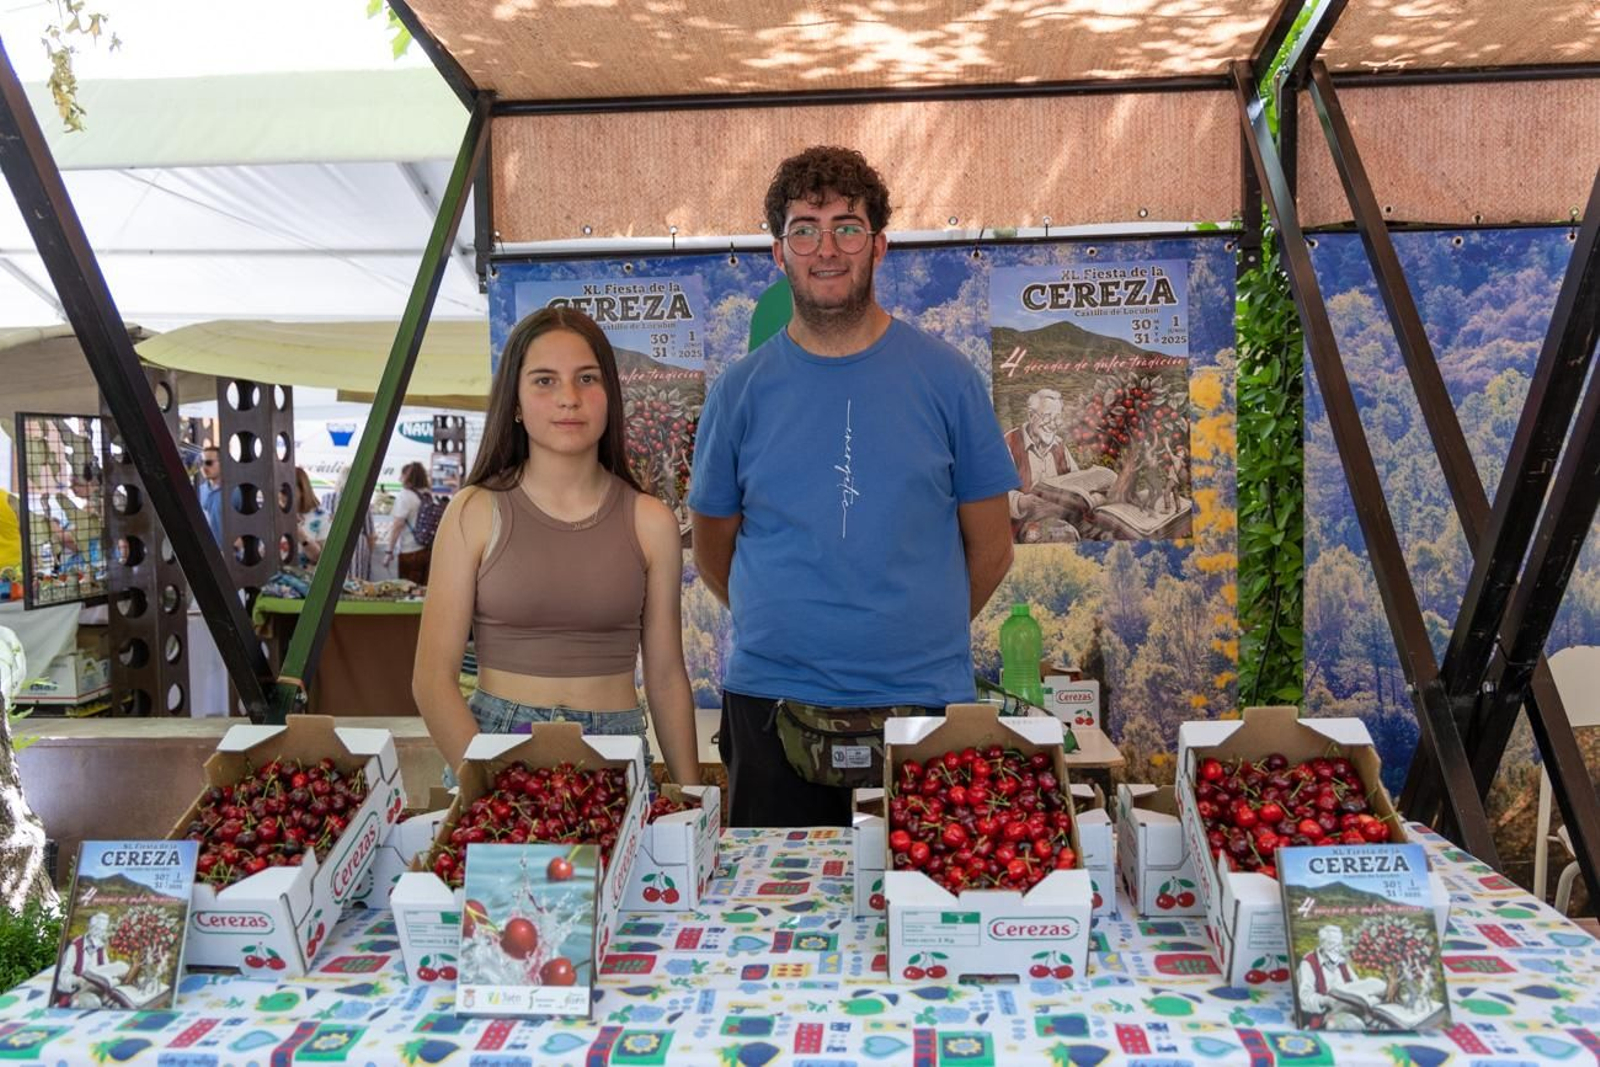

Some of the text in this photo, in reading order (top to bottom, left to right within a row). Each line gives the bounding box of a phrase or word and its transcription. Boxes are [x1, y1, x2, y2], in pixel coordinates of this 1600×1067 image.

[1061, 266, 1164, 281] XL Fiesta de la
[583, 281, 681, 295] XL Fiesta de la
[1022, 278, 1177, 311] CEREZA
[1131, 319, 1152, 331] 30
[1172, 315, 1180, 327] 1
[650, 333, 669, 345] 30
[688, 330, 696, 342] 1
[1134, 333, 1151, 344] 31
[1161, 335, 1187, 344] 2025
[652, 347, 668, 358] 31
[678, 348, 703, 358] 2025
[1000, 346, 1028, 378] 4
[1058, 691, 1093, 702] Cerezas
[101, 850, 180, 866] CEREZA
[333, 823, 378, 898] Cerezas
[1308, 855, 1410, 874] CEREZA
[1297, 897, 1315, 918] 4
[196, 912, 269, 929] Cerezas
[992, 921, 1072, 937] Cerezas
